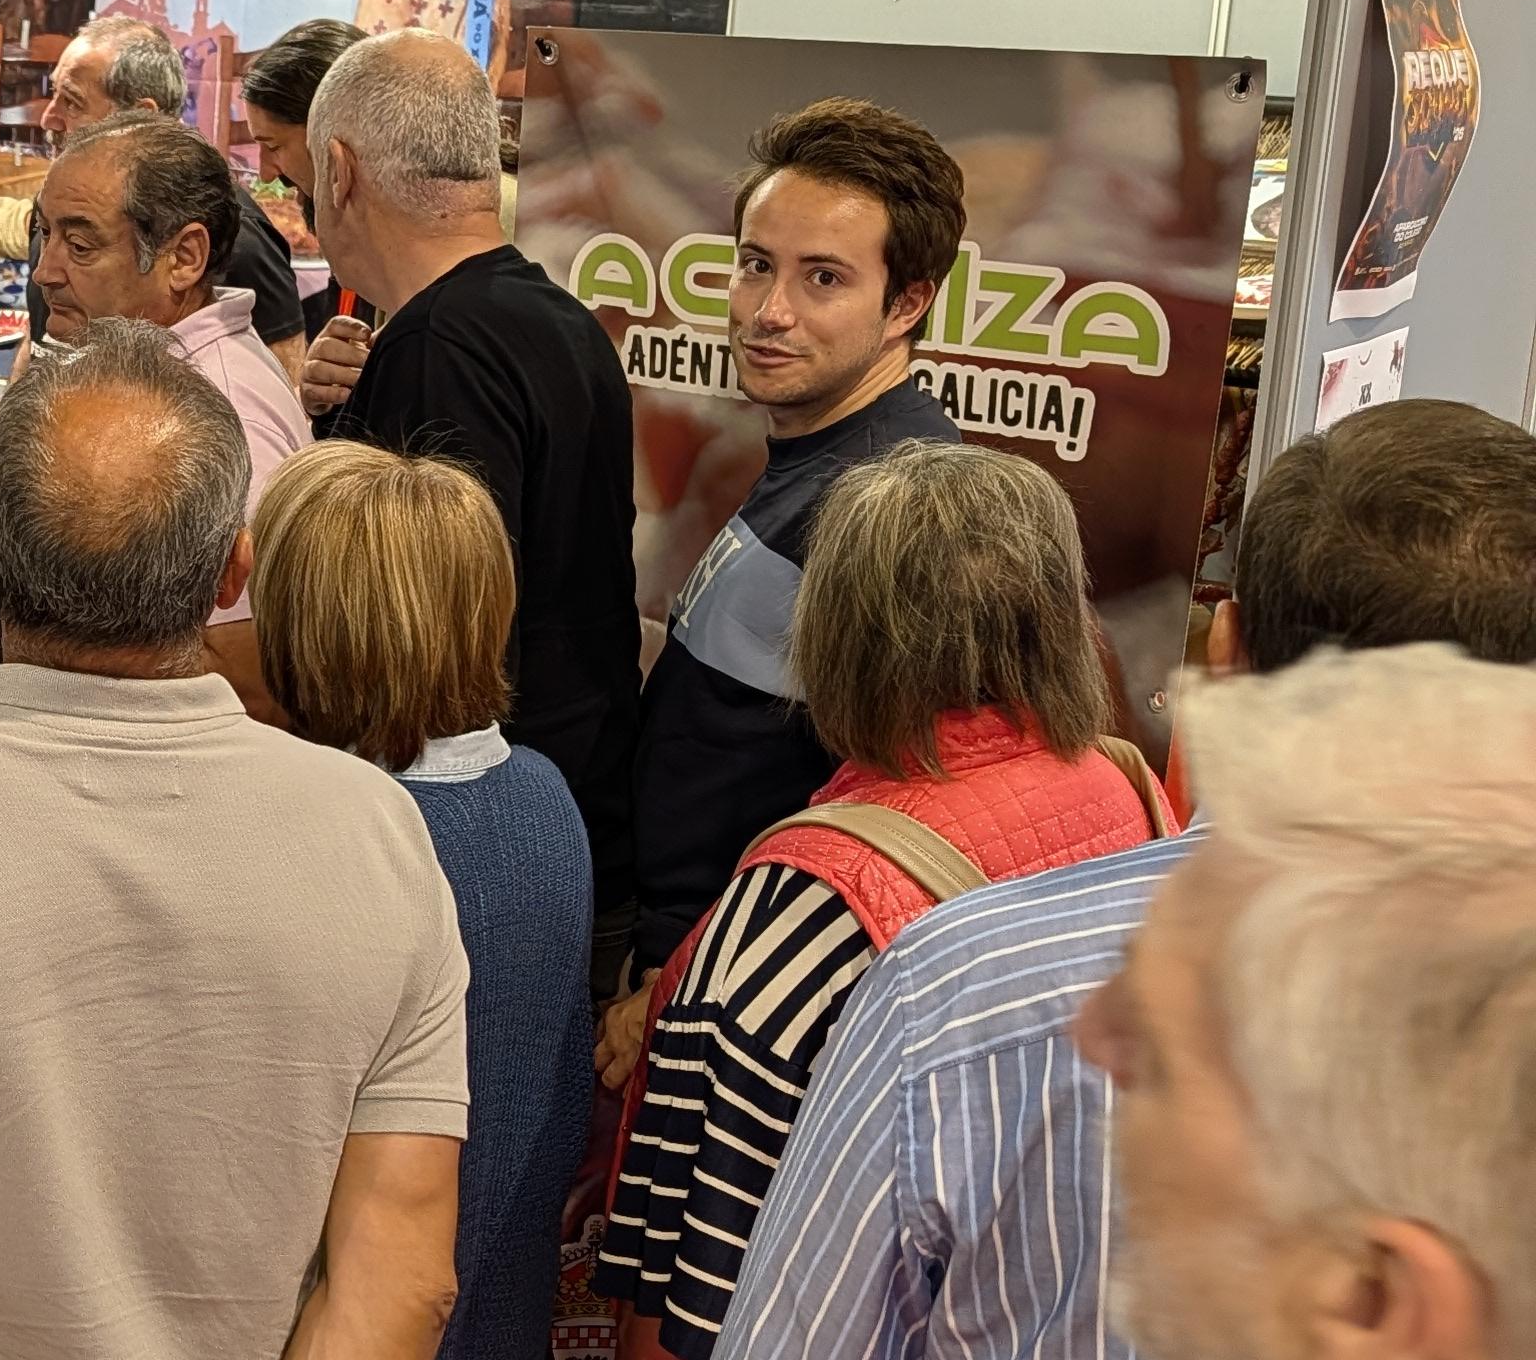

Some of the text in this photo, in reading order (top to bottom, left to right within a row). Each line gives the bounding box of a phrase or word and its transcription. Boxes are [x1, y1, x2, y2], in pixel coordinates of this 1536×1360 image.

[1404, 48, 1469, 91] REQUE
[667, 242, 1161, 368] CIZA
[627, 333, 742, 390] ADÉNT
